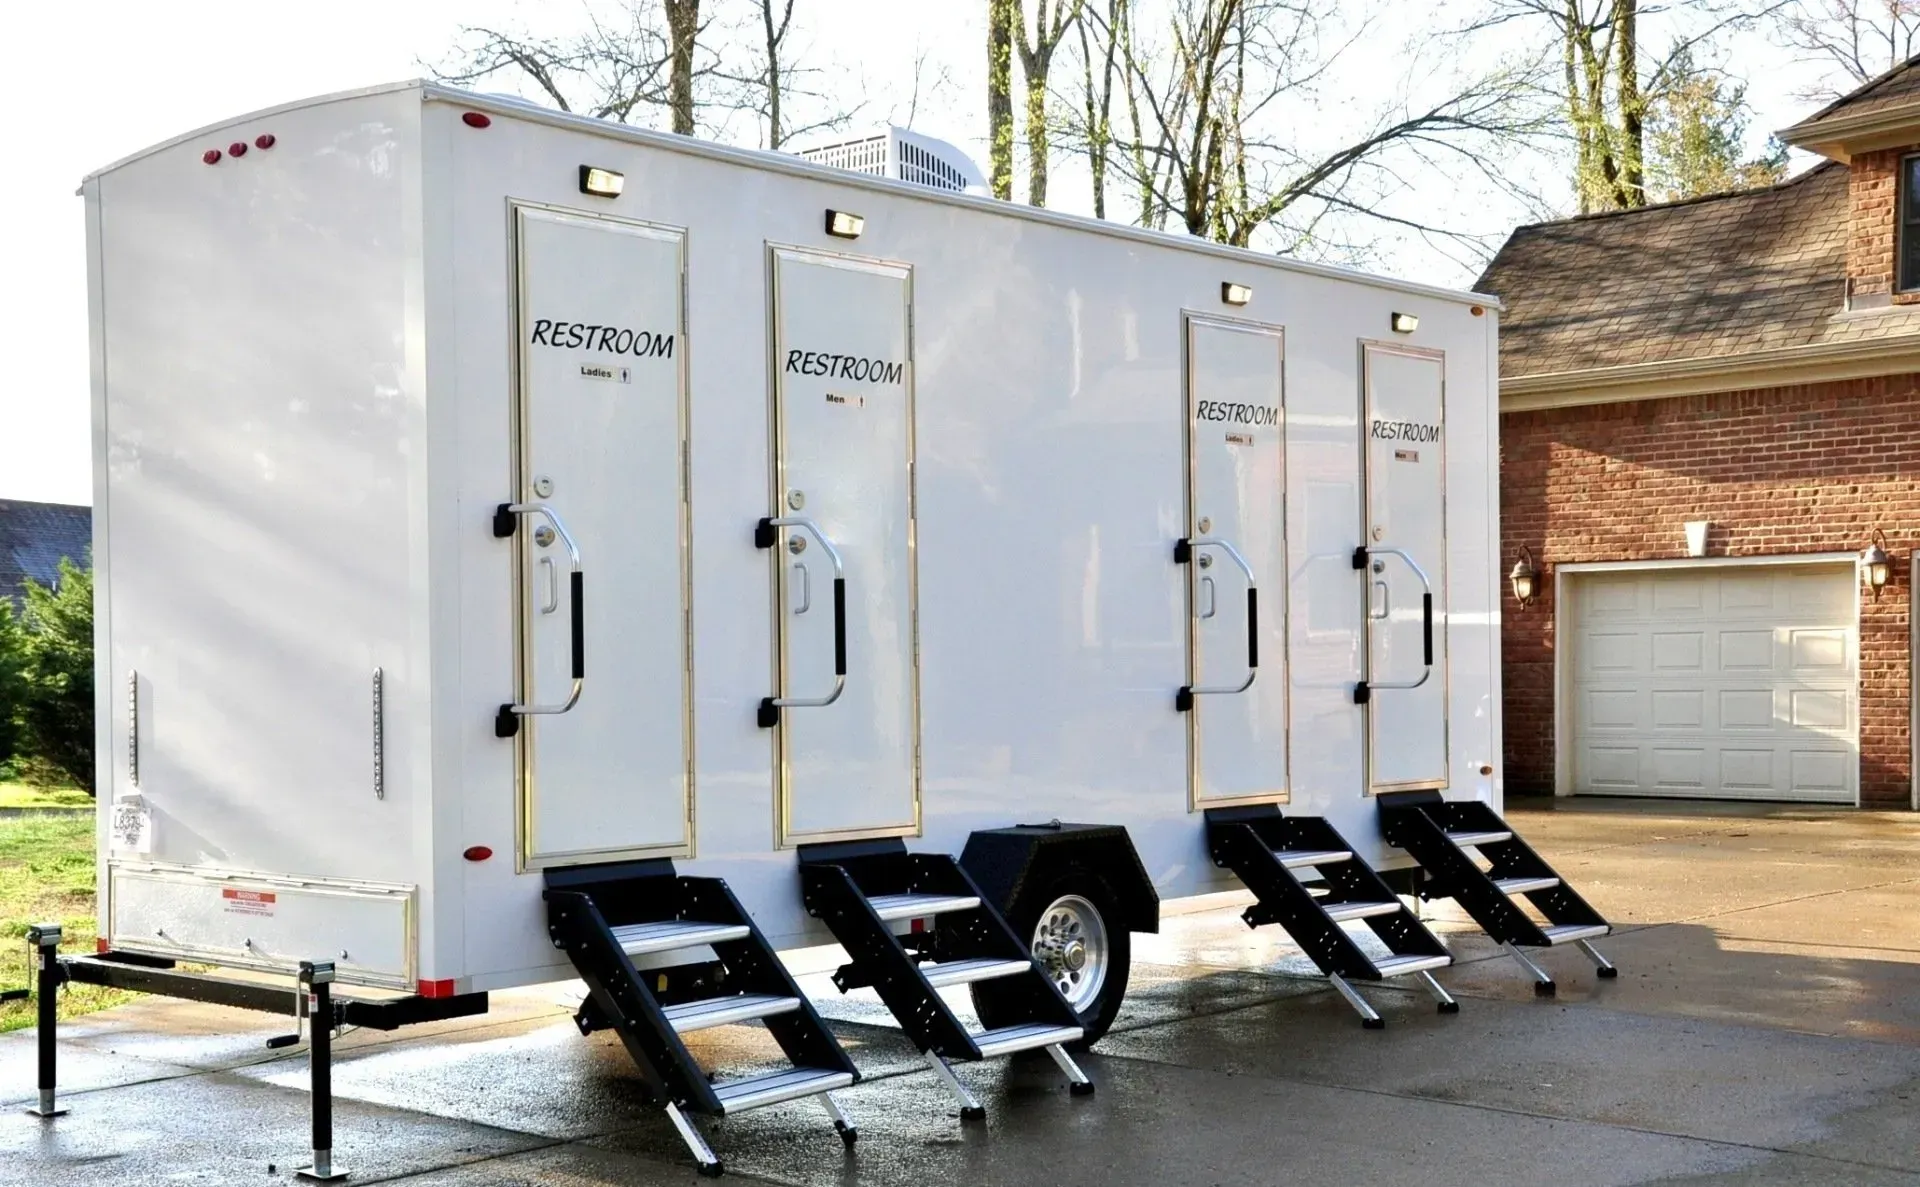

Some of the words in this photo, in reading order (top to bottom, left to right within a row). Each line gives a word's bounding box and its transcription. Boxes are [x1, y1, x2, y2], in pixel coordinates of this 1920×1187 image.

[532, 319, 674, 359] RESTROOM
[581, 366, 612, 379] Ladies
[786, 350, 902, 385] RESTROOM
[826, 393, 845, 404] Men
[1197, 400, 1277, 426] RESTROOM
[1371, 420, 1440, 443] RESTROOM
